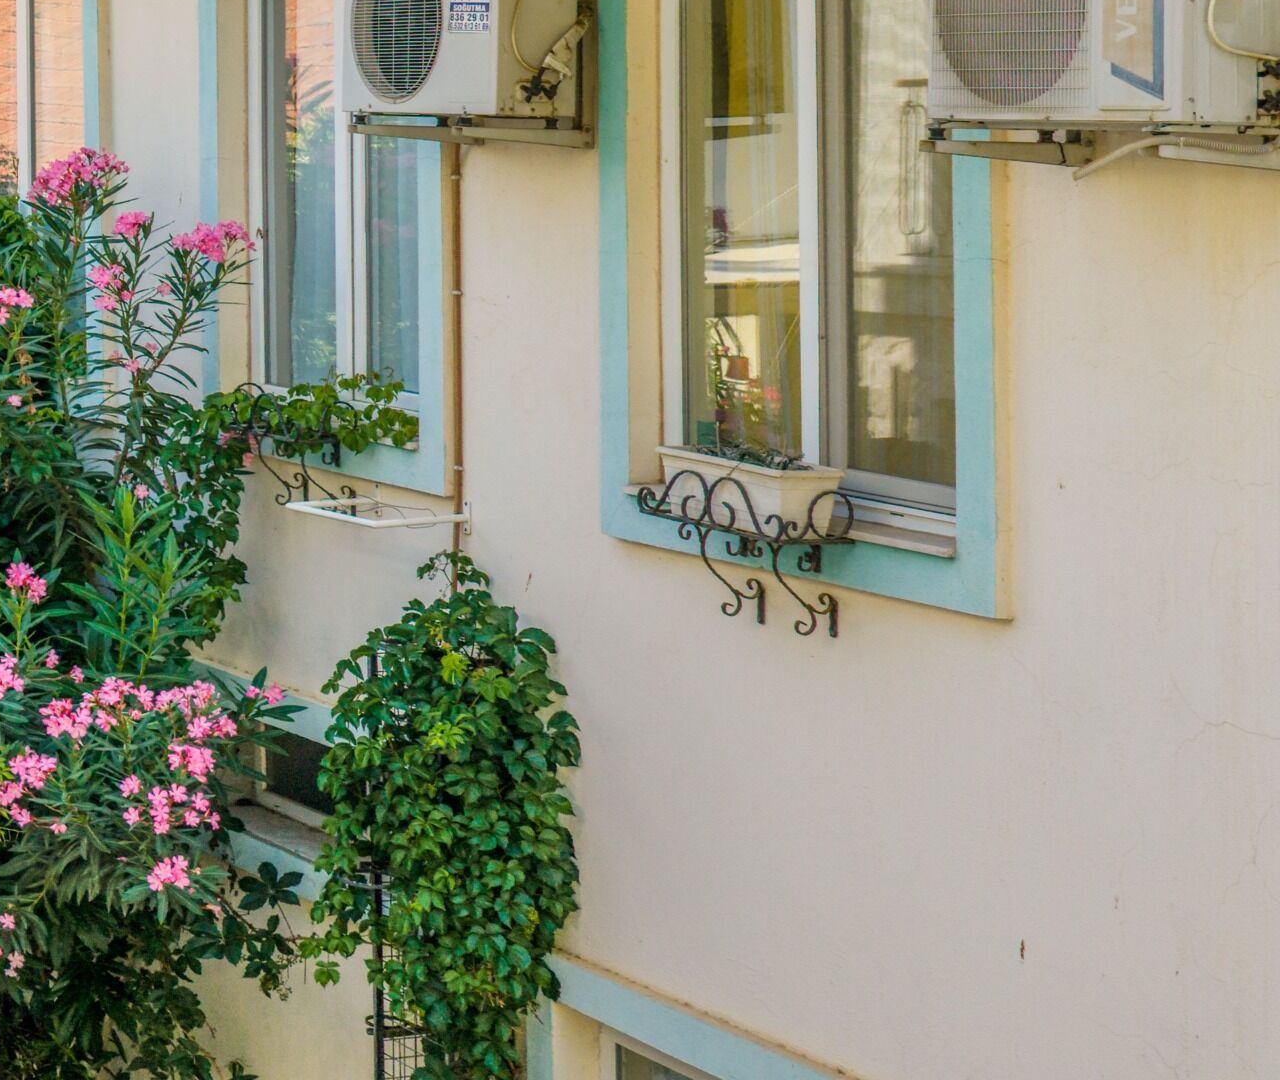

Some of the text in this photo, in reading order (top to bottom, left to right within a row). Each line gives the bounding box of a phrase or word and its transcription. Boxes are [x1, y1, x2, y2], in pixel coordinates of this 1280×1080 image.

[450, 13, 489, 22] 836 29 01
